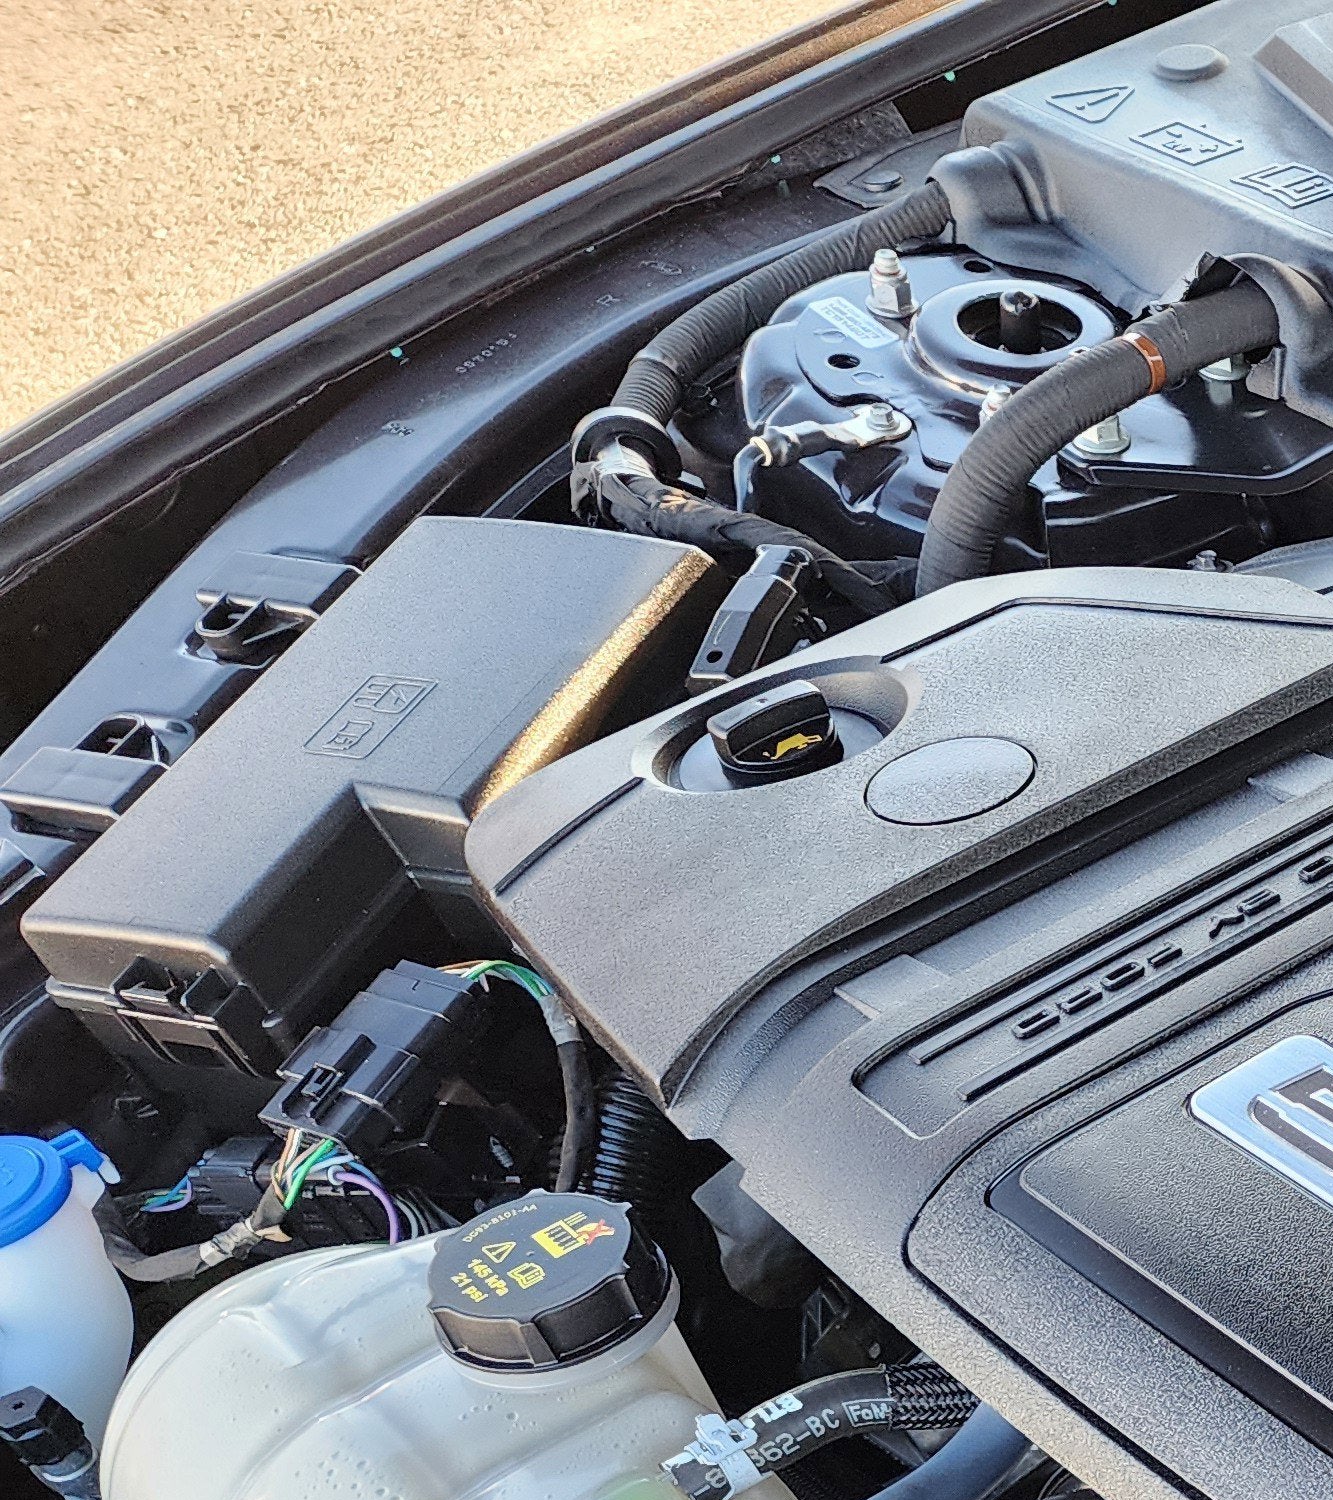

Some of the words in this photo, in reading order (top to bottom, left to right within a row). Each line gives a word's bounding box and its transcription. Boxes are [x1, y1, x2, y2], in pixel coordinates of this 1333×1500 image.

[450, 1272, 473, 1288] 21
[467, 1258, 493, 1280] 145
[485, 1274, 509, 1297] kPa
[461, 1285, 489, 1303] psi
